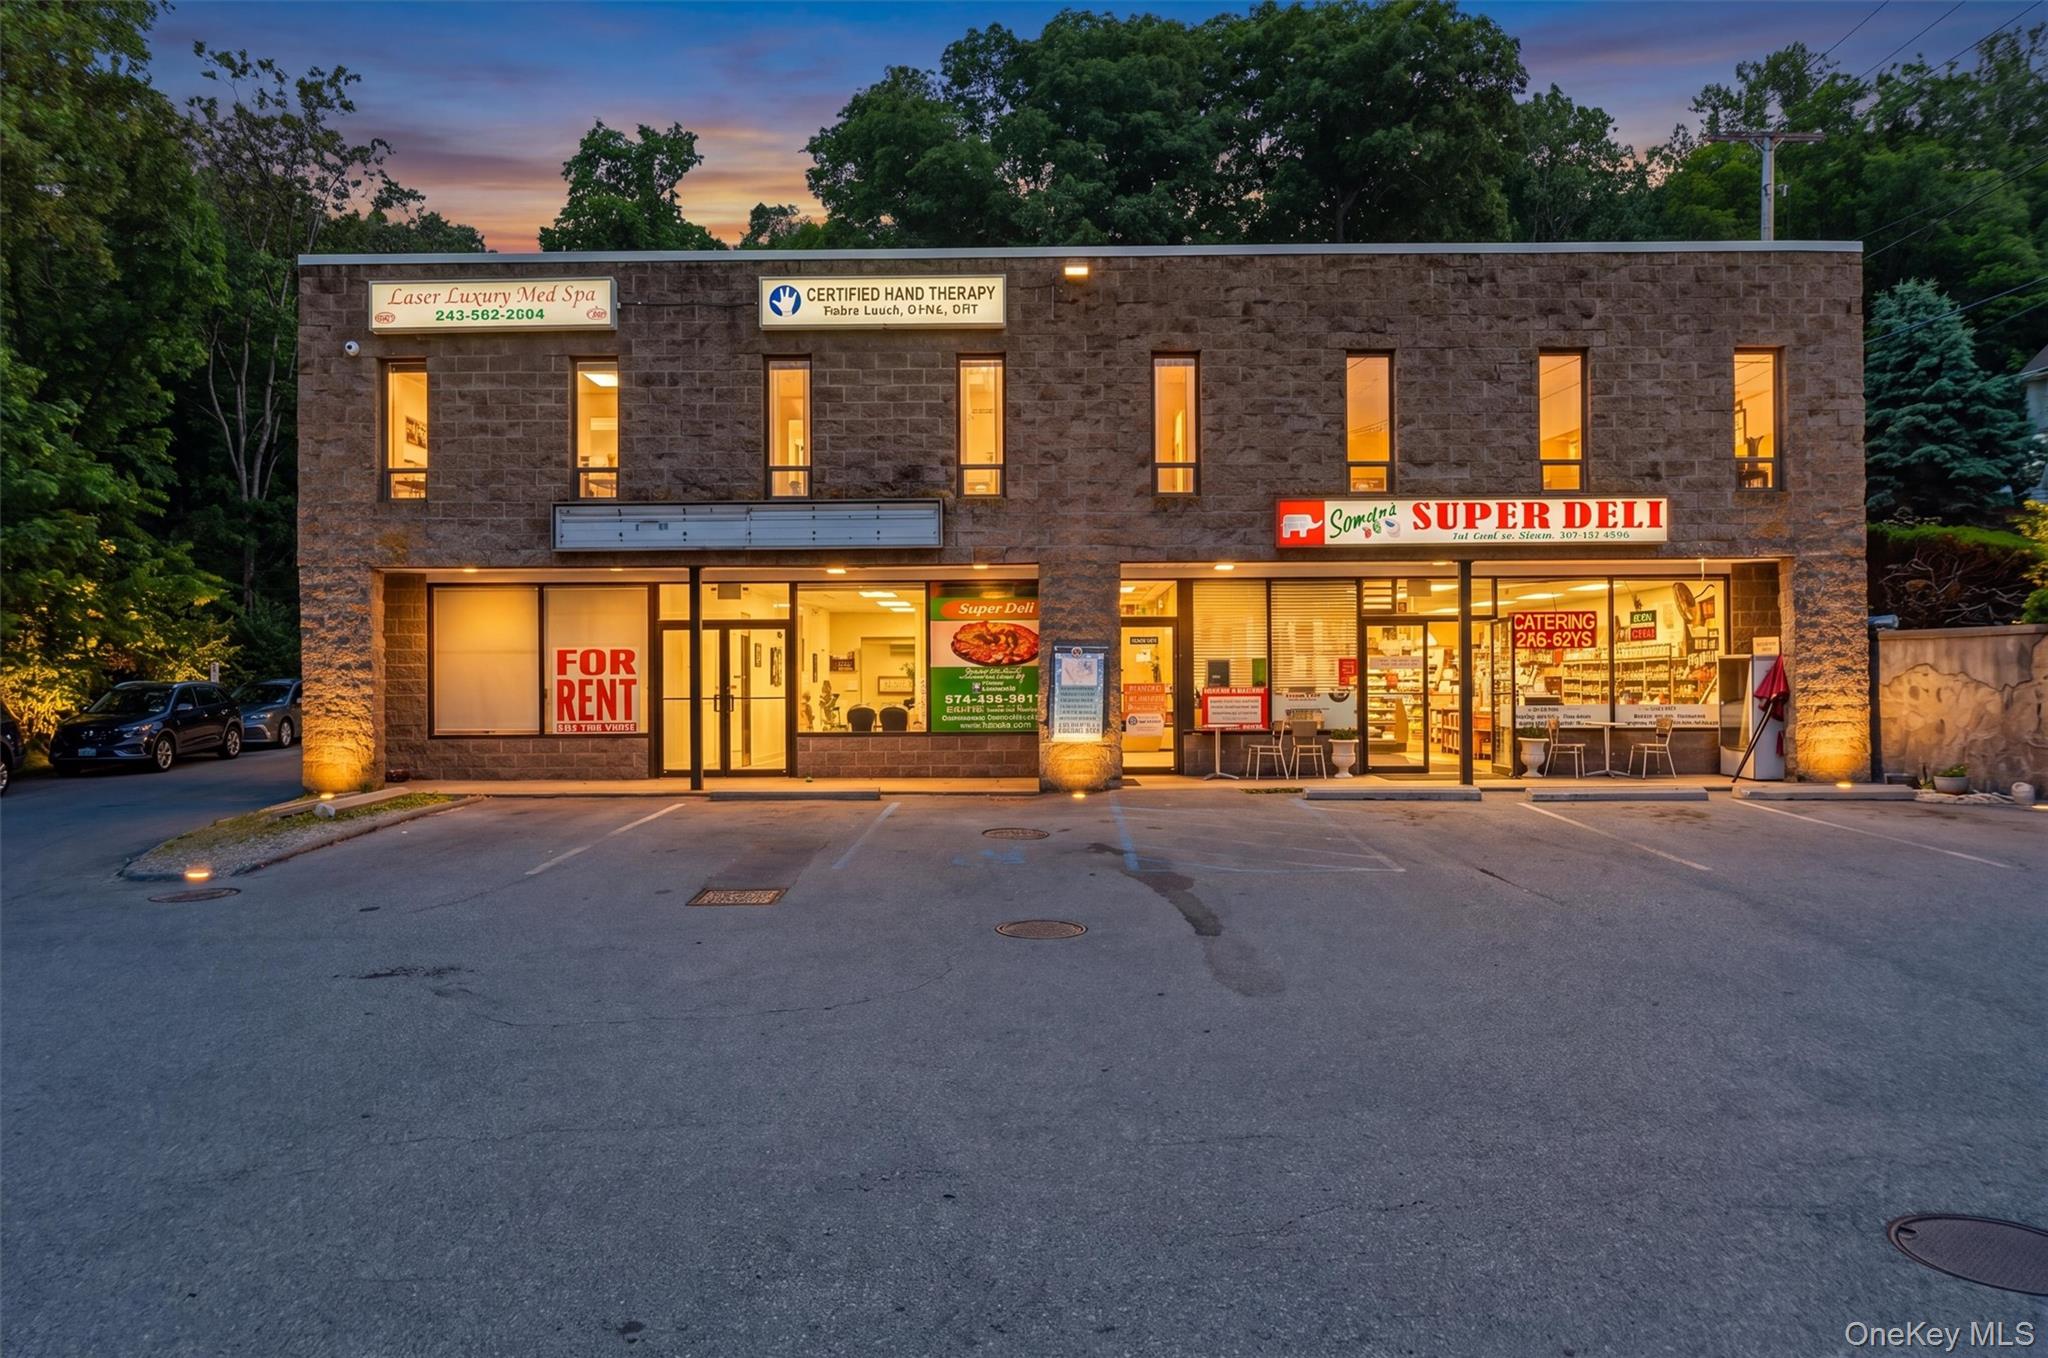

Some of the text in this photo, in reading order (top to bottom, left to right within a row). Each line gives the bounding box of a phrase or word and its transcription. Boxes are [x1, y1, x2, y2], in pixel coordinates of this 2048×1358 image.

[388, 285, 596, 308] Laser Luxury Med Spa
[807, 285, 996, 302] CERTIFIED HAND THERAPY
[1412, 500, 1663, 530] SUPER DELI
[958, 602, 1036, 617] Super Deli
[1513, 613, 1595, 630] CATERING
[557, 649, 636, 676] FOR
[557, 679, 637, 721] RENT
